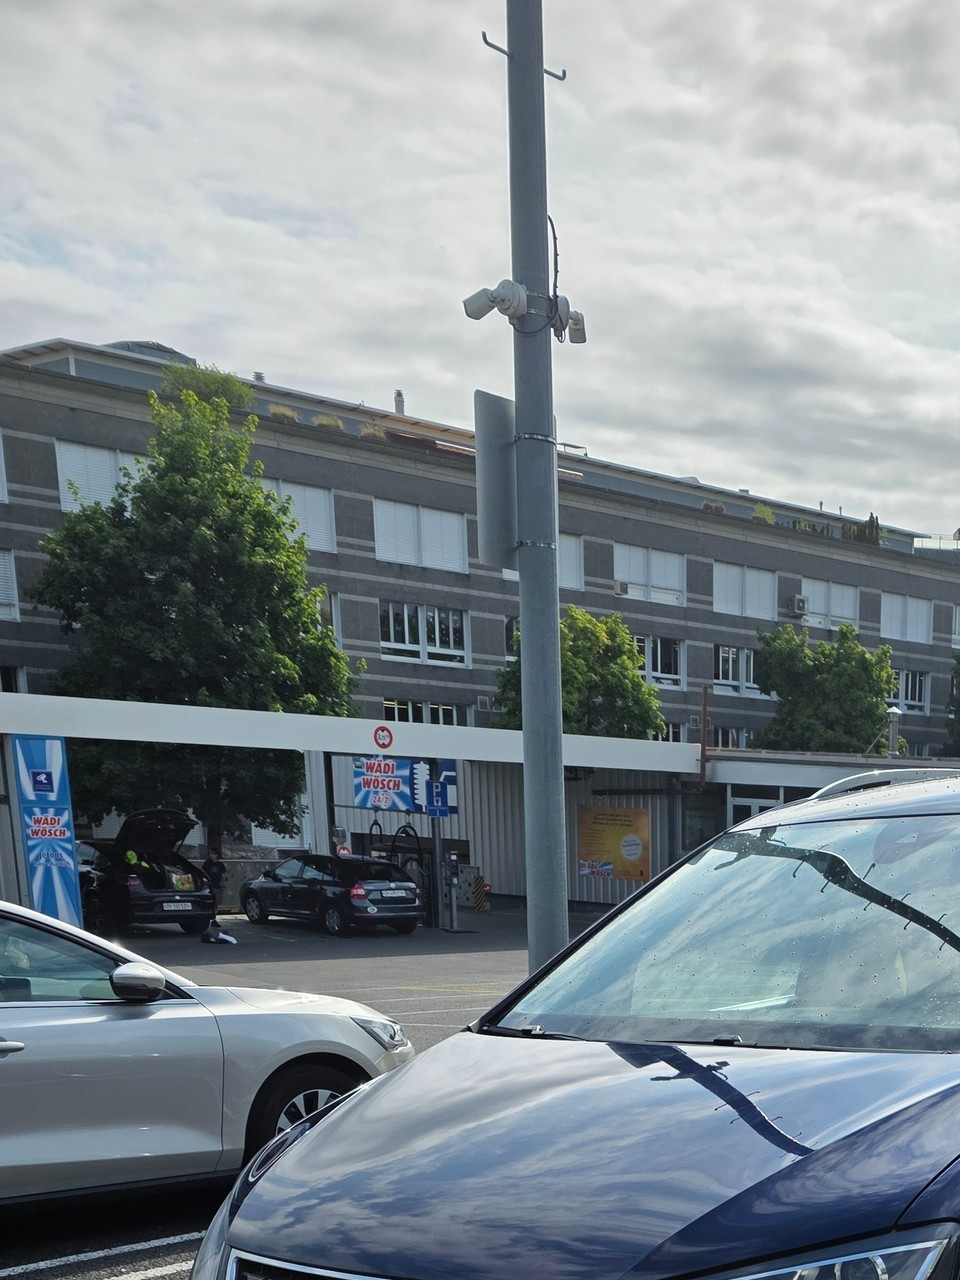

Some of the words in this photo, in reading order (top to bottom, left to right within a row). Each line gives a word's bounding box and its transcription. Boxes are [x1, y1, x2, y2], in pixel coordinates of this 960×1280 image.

[365, 760, 395, 774] WÄDI
[362, 775, 401, 791] WÖSCH
[433, 783, 441, 796] P
[33, 815, 60, 826] WÄDI
[30, 826, 66, 838] WÖSCH
